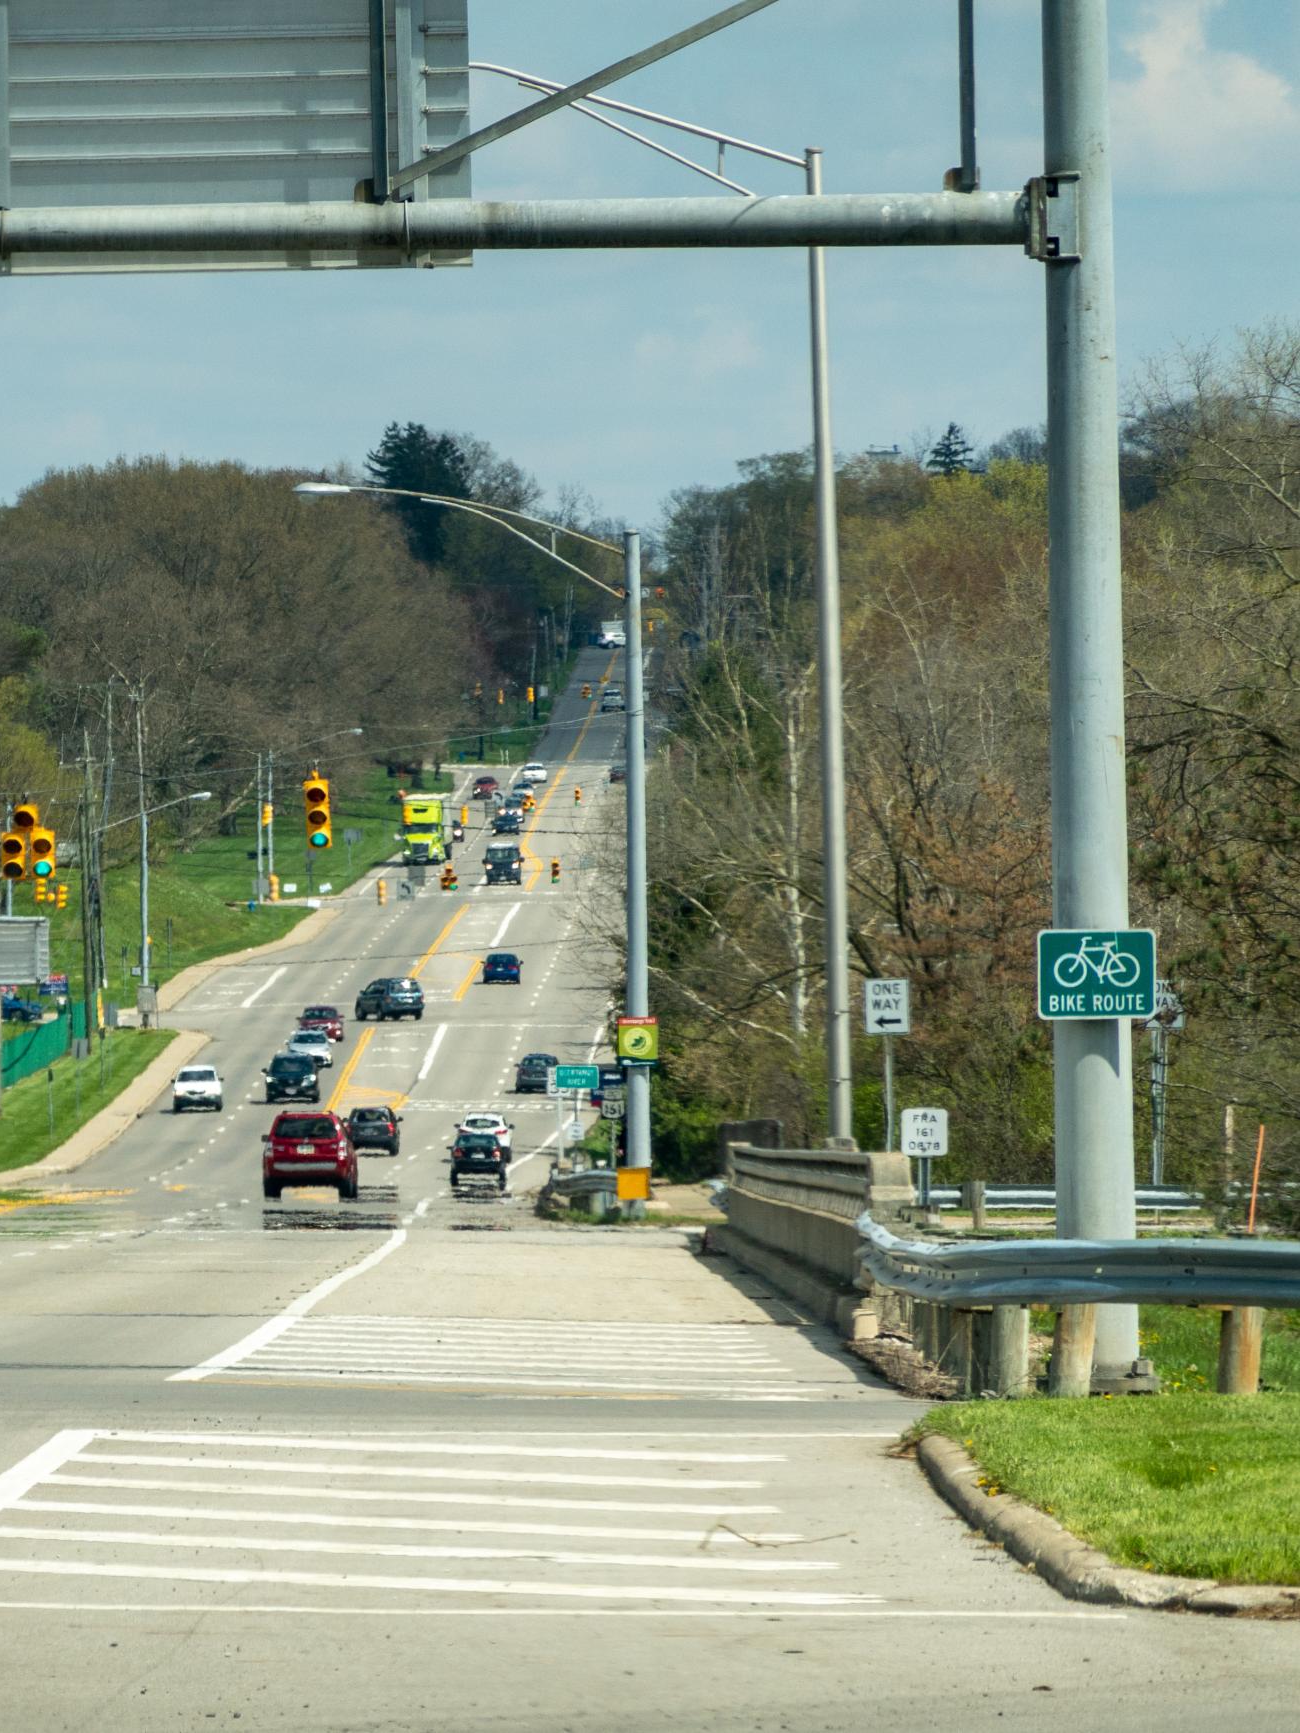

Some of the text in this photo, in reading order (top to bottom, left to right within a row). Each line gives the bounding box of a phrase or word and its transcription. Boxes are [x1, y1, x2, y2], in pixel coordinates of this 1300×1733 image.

[872, 984, 901, 995] ONE
[872, 998, 901, 1010] WAY
[1049, 994, 1145, 1011] BIKE ROUTE
[913, 1114, 938, 1122] FRA
